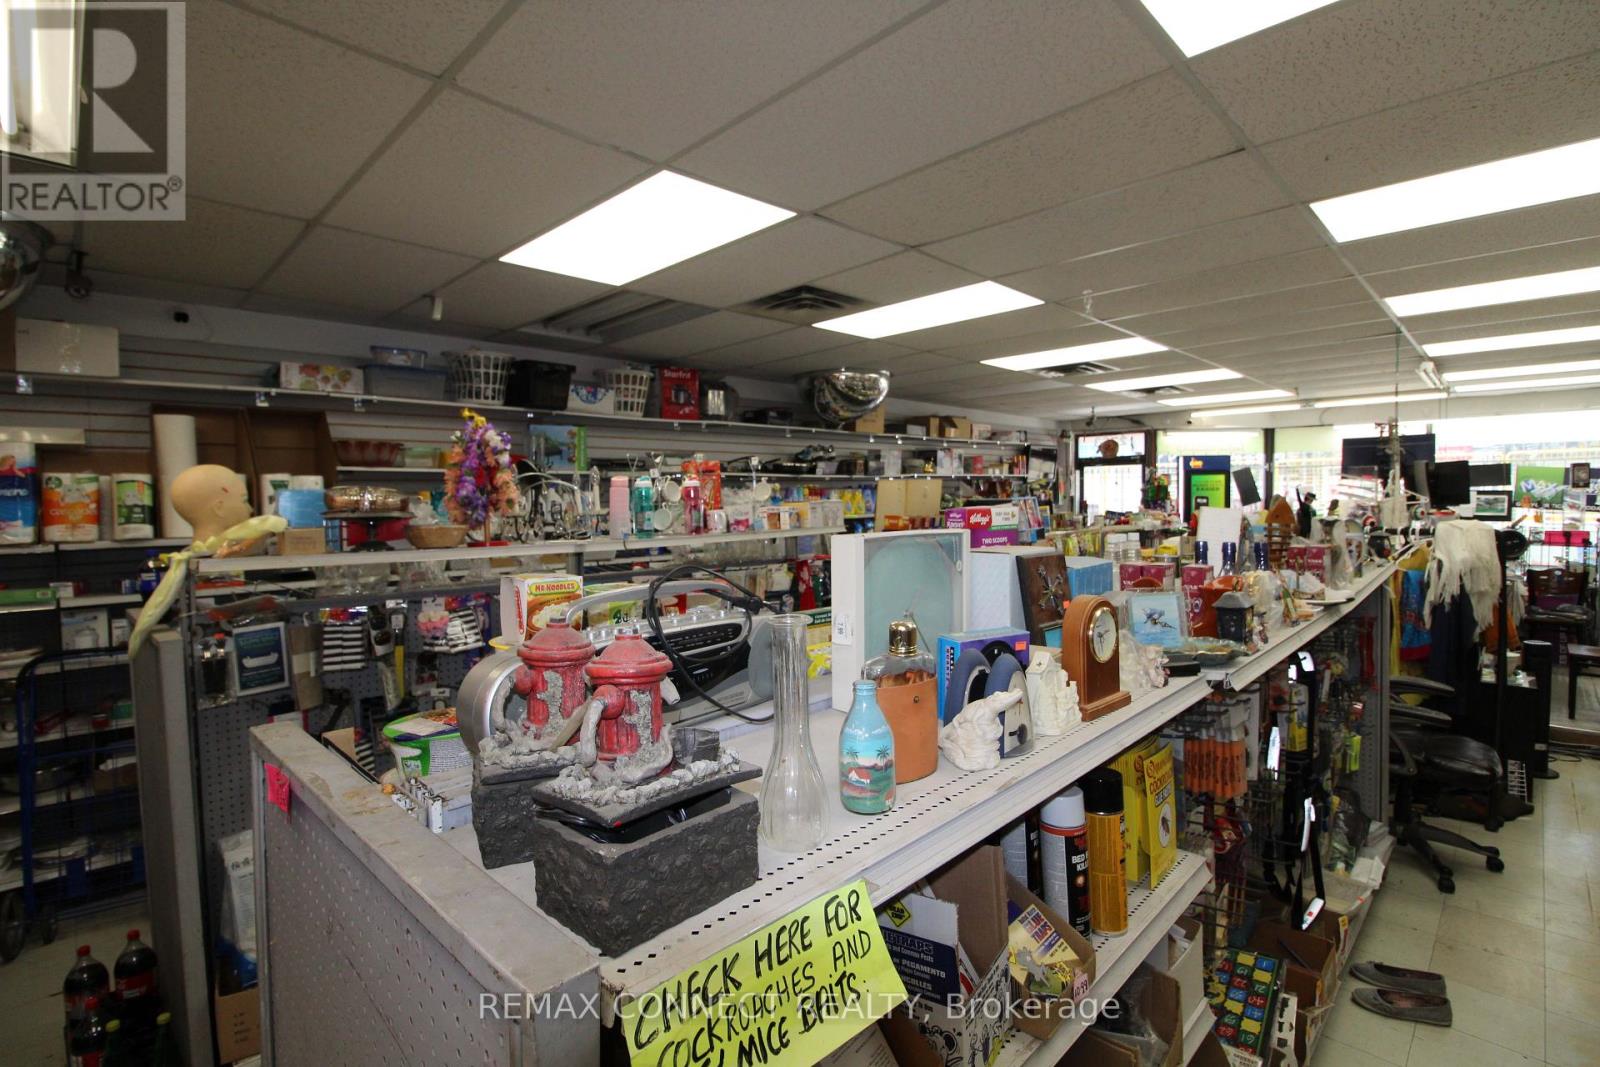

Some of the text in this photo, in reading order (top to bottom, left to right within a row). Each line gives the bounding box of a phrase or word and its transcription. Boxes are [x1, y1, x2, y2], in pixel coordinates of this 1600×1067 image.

[981, 536, 1008, 545] TWO SCOOPS
[634, 889, 862, 1050] CHECK HERE FOR
[656, 929, 871, 1067] COCKROACHES AND
[737, 1016, 791, 1067] MICE
